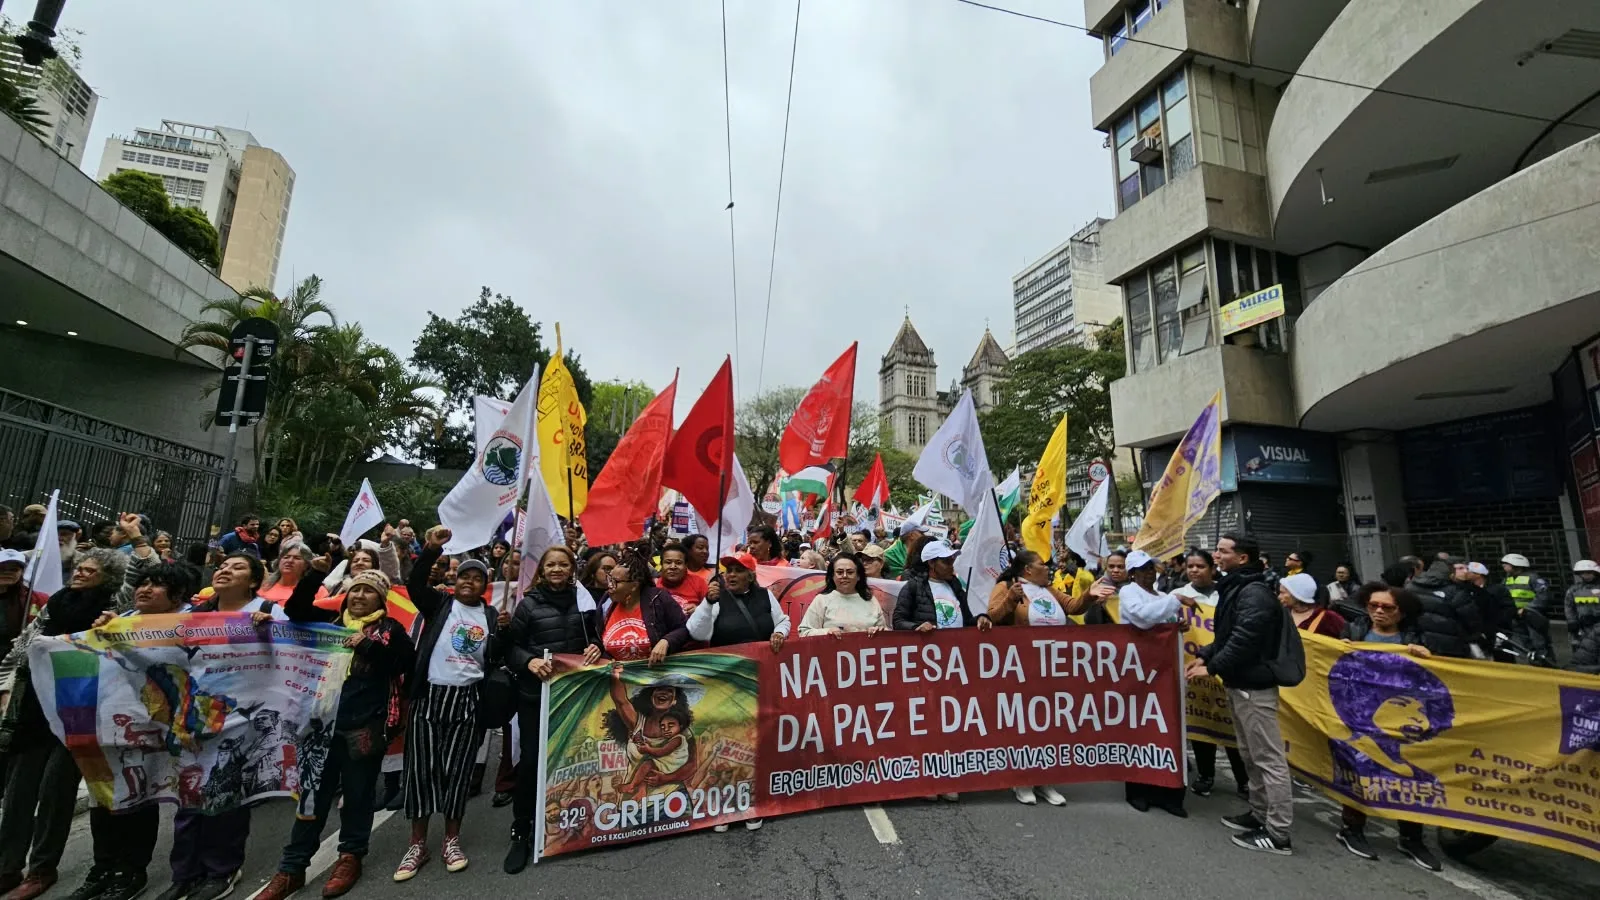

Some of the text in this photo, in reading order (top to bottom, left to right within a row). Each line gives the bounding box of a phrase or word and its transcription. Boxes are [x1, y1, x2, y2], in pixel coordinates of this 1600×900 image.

[1240, 288, 1280, 309] MIRO
[1260, 445, 1311, 462] VISUAL
[779, 639, 1158, 699] NA DEFESA DA TERRA,
[777, 690, 1169, 753] DA PAZ E DA MORADIA
[601, 752, 628, 769] NÃ
[1470, 748, 1485, 760] A
[556, 760, 598, 783] DEMOCR
[769, 742, 1178, 796] ERGUEMOS A VOZ: MULHERES VIVAS E SOBERANIA
[1455, 763, 1512, 784] porta
[559, 782, 751, 831] 32º GRITO 2026
[1464, 795, 1536, 817] outros
[1528, 787, 1593, 815] todos
[591, 835, 607, 844] DOS
[609, 828, 647, 841] EXCLUÍDOS
[653, 820, 690, 833] EXCLUÍDAS
